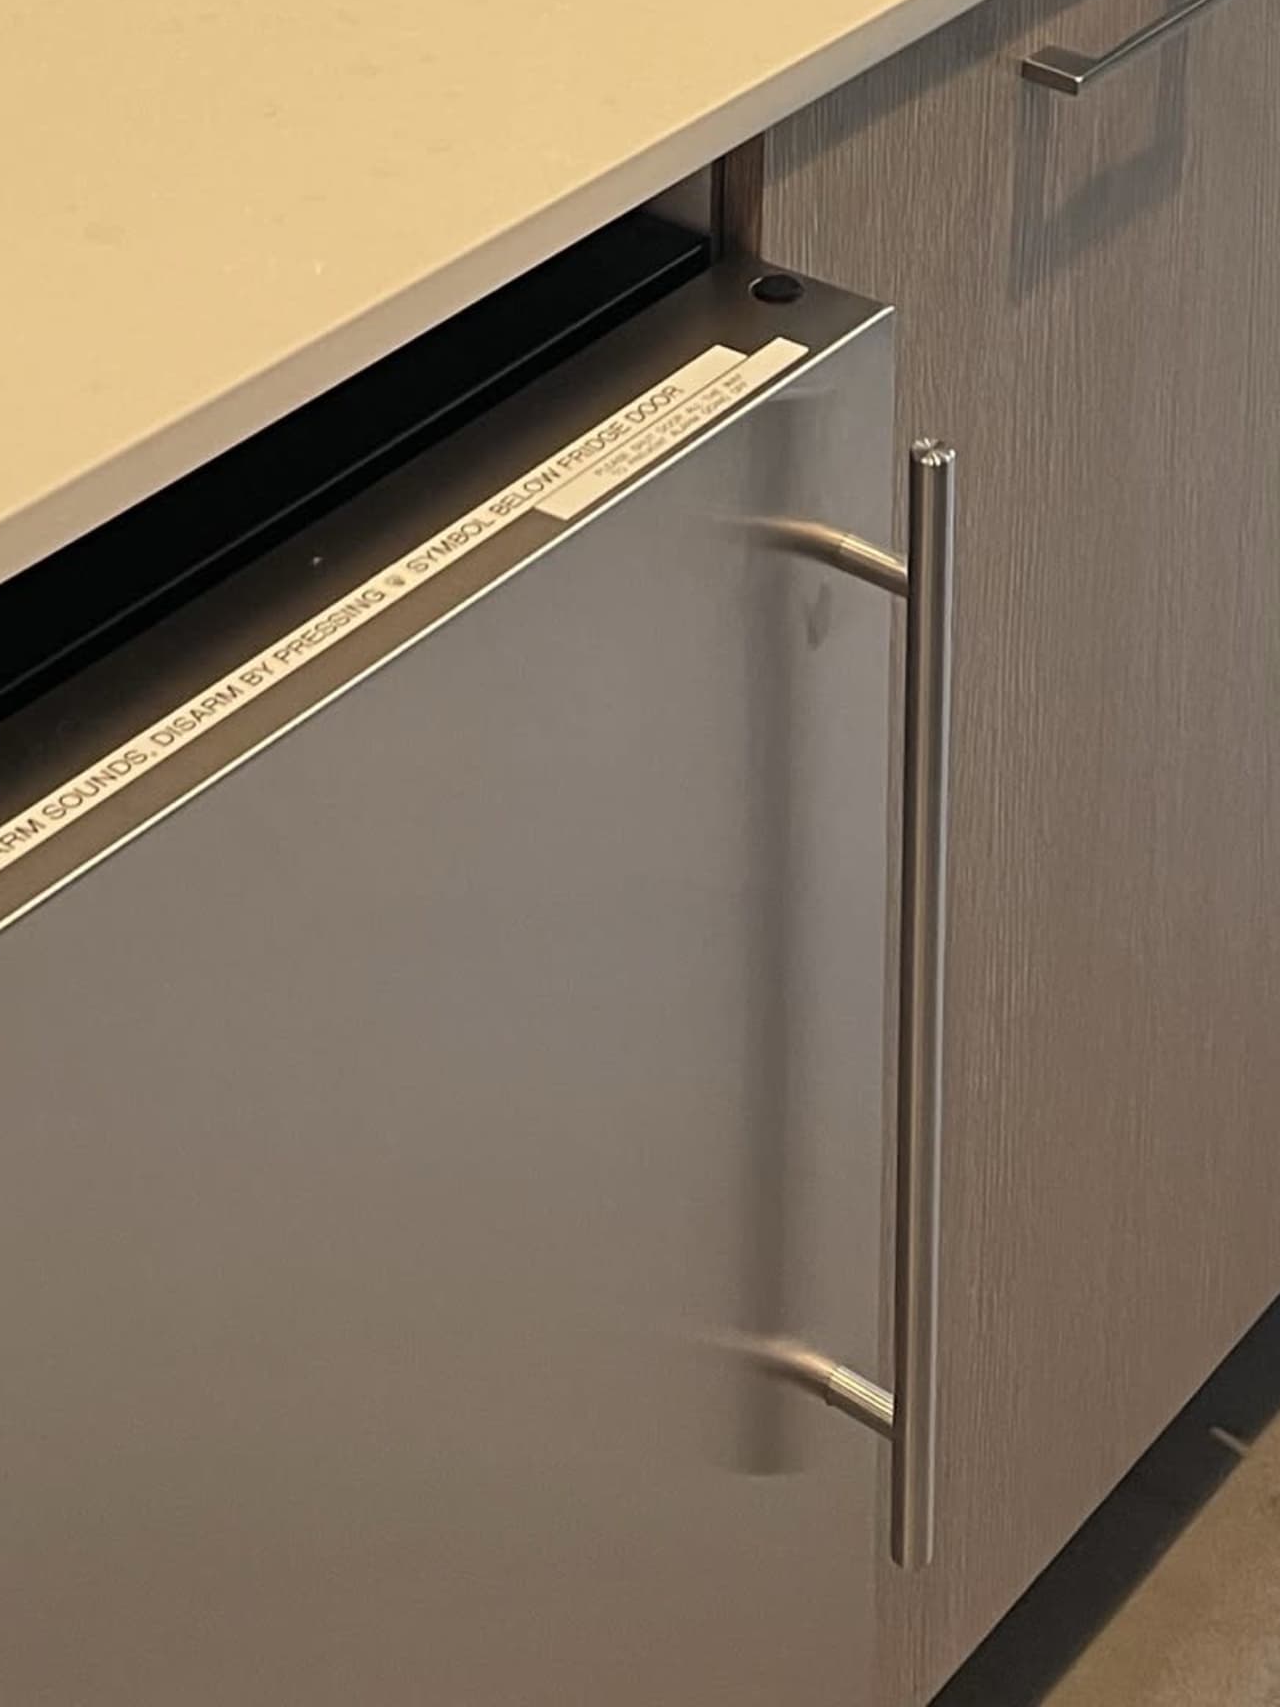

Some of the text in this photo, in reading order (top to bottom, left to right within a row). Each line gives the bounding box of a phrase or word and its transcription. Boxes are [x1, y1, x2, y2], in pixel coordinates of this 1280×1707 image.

[149, 684, 244, 748] DISARM
[239, 660, 275, 688] BY
[273, 587, 385, 665] PRESSING
[406, 516, 495, 573] SYMBOL
[489, 465, 561, 519] BELOW
[556, 419, 630, 471] FRIDGE
[624, 384, 685, 424] DOOR
